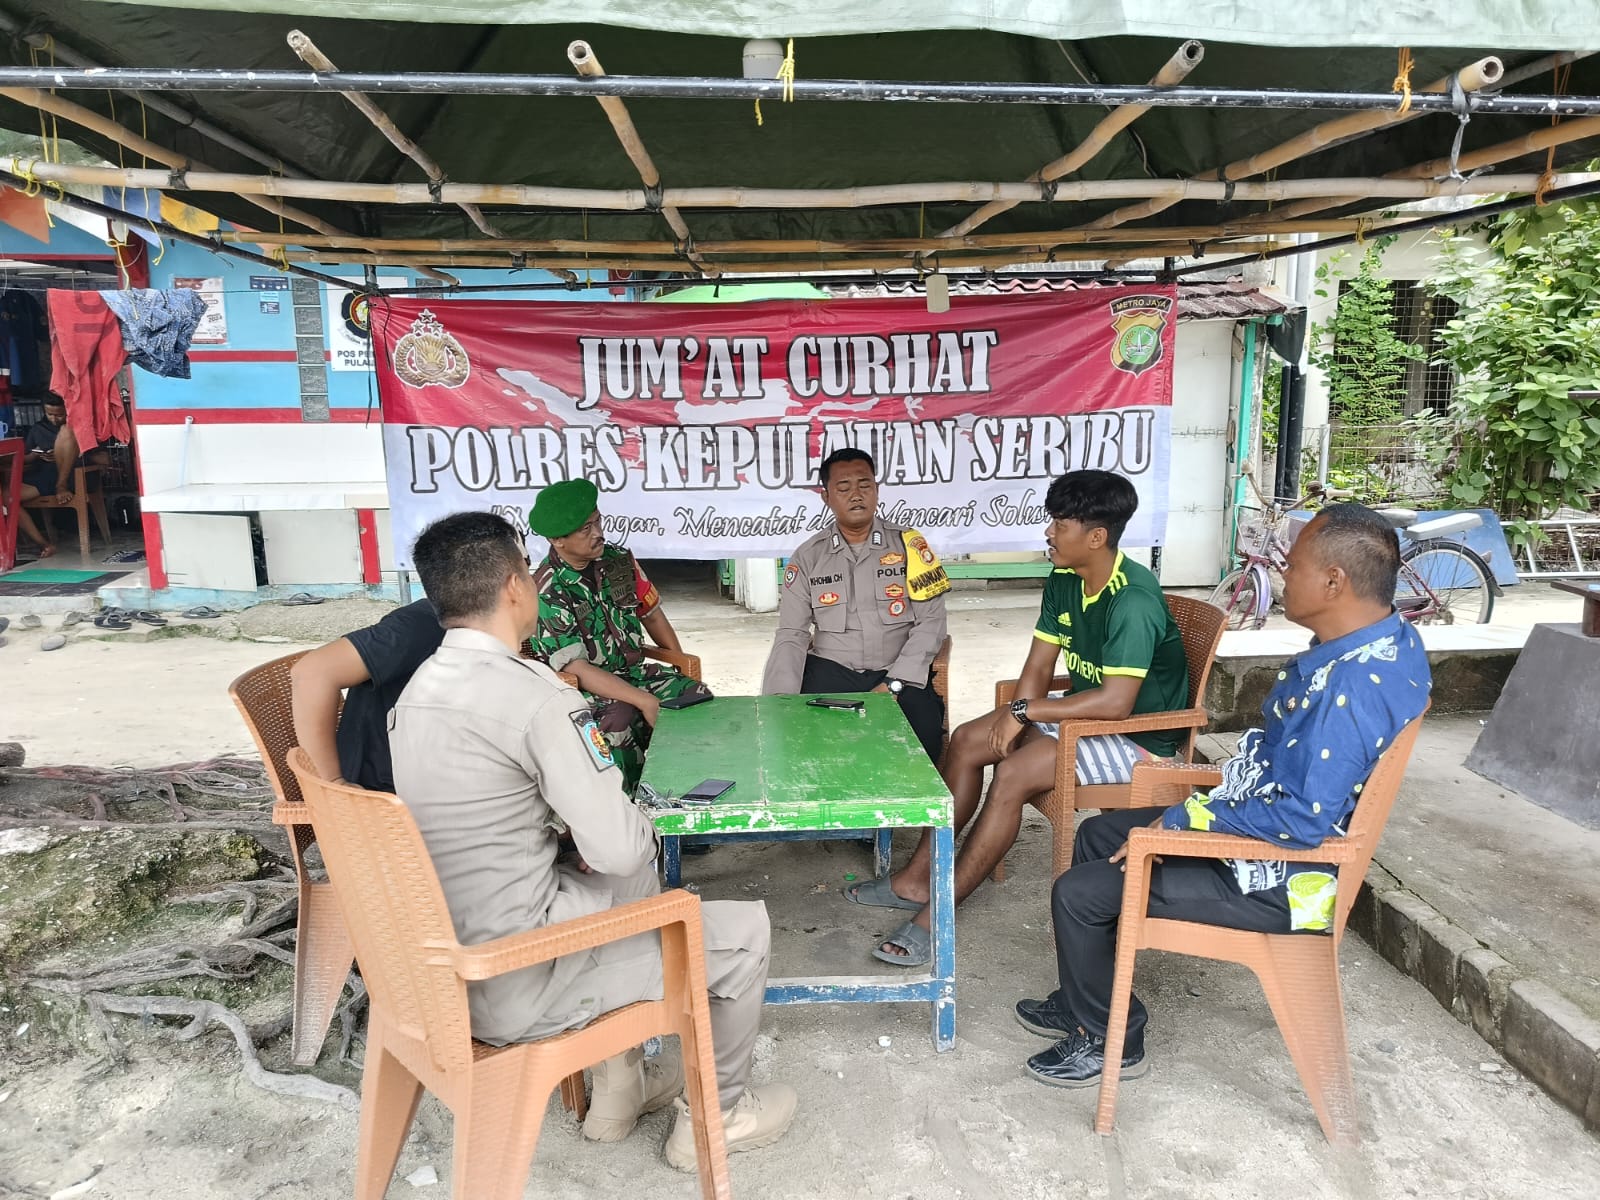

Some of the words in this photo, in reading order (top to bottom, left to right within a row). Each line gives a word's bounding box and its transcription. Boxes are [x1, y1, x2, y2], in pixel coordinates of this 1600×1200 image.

[1116, 299, 1145, 310] METRO
[1146, 299, 1167, 308] JAYA
[337, 350, 356, 358] POS
[576, 336, 769, 411] JUM'AT
[786, 330, 998, 397] CURHAT
[407, 424, 627, 493] POLRES
[970, 410, 1154, 482] SERIBU
[673, 505, 807, 537] Mencatat
[875, 499, 977, 528] Mencari
